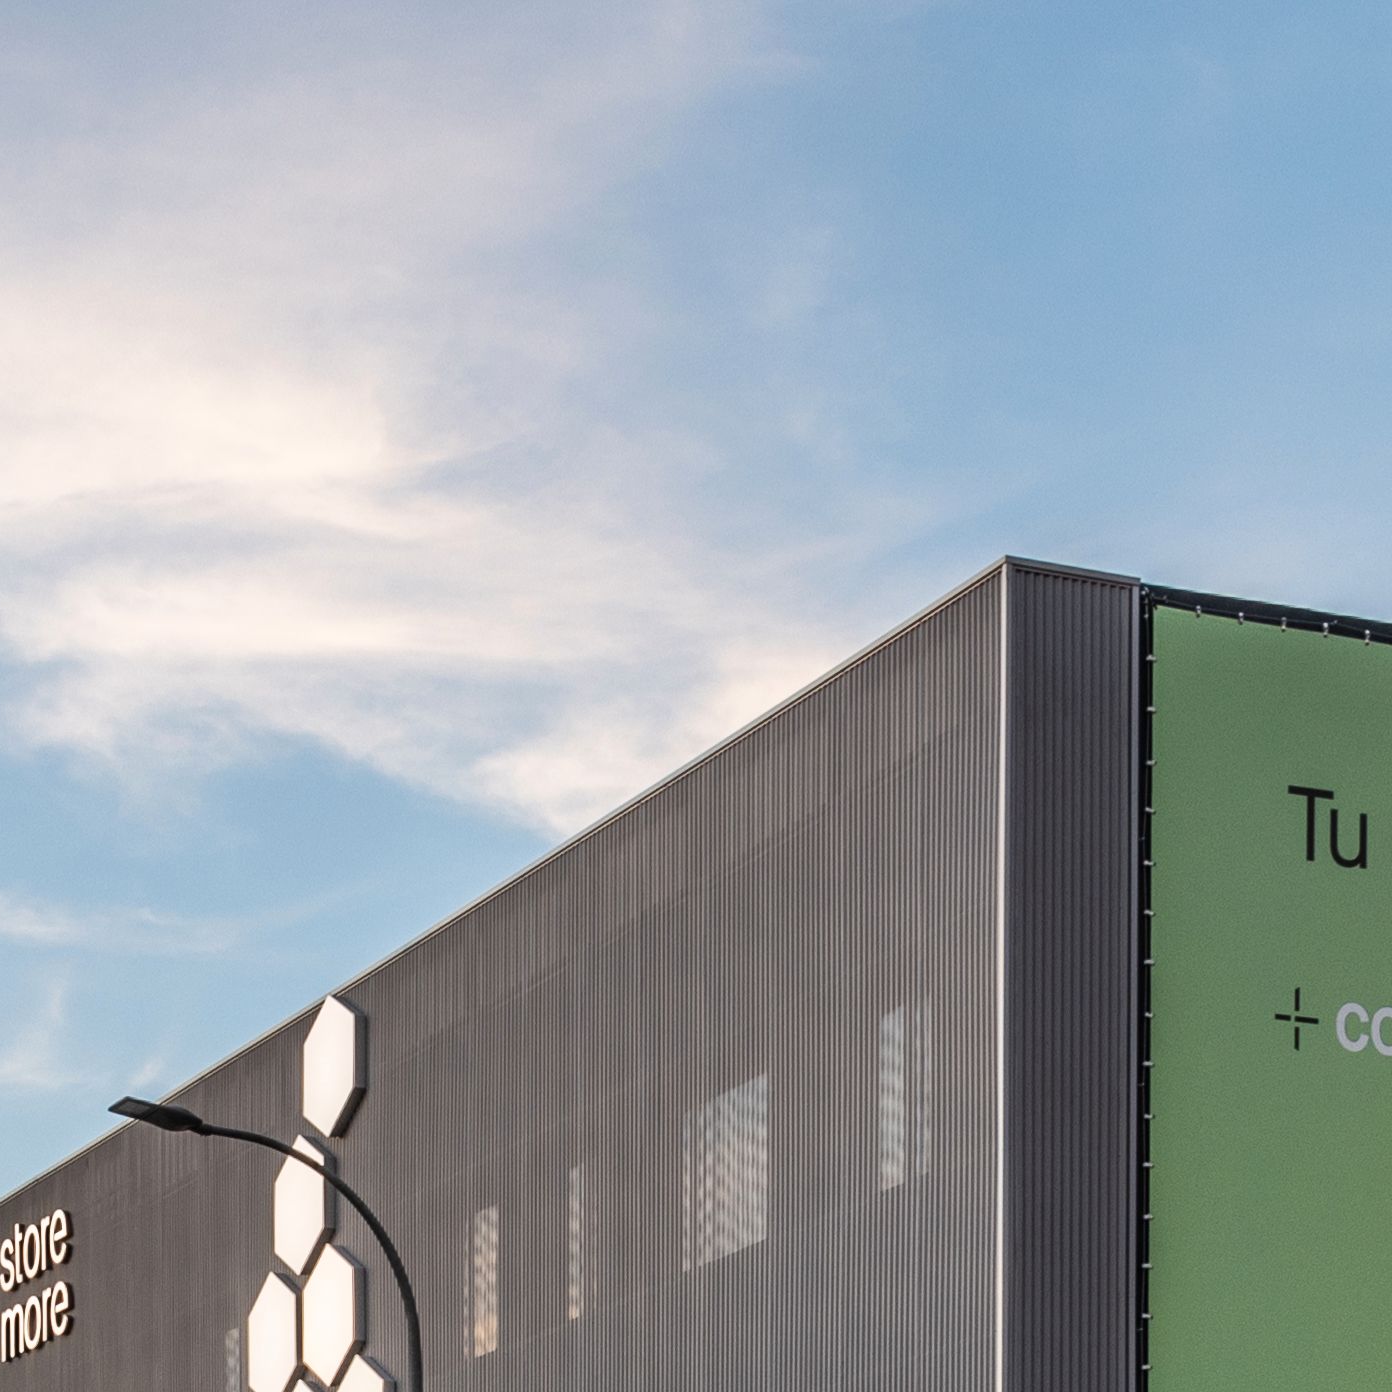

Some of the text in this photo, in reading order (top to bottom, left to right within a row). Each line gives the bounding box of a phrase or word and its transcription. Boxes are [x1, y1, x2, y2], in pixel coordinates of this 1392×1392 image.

[1287, 785, 1368, 869] Tu
[0, 1208, 68, 1292] store
[1, 1280, 69, 1363] more
